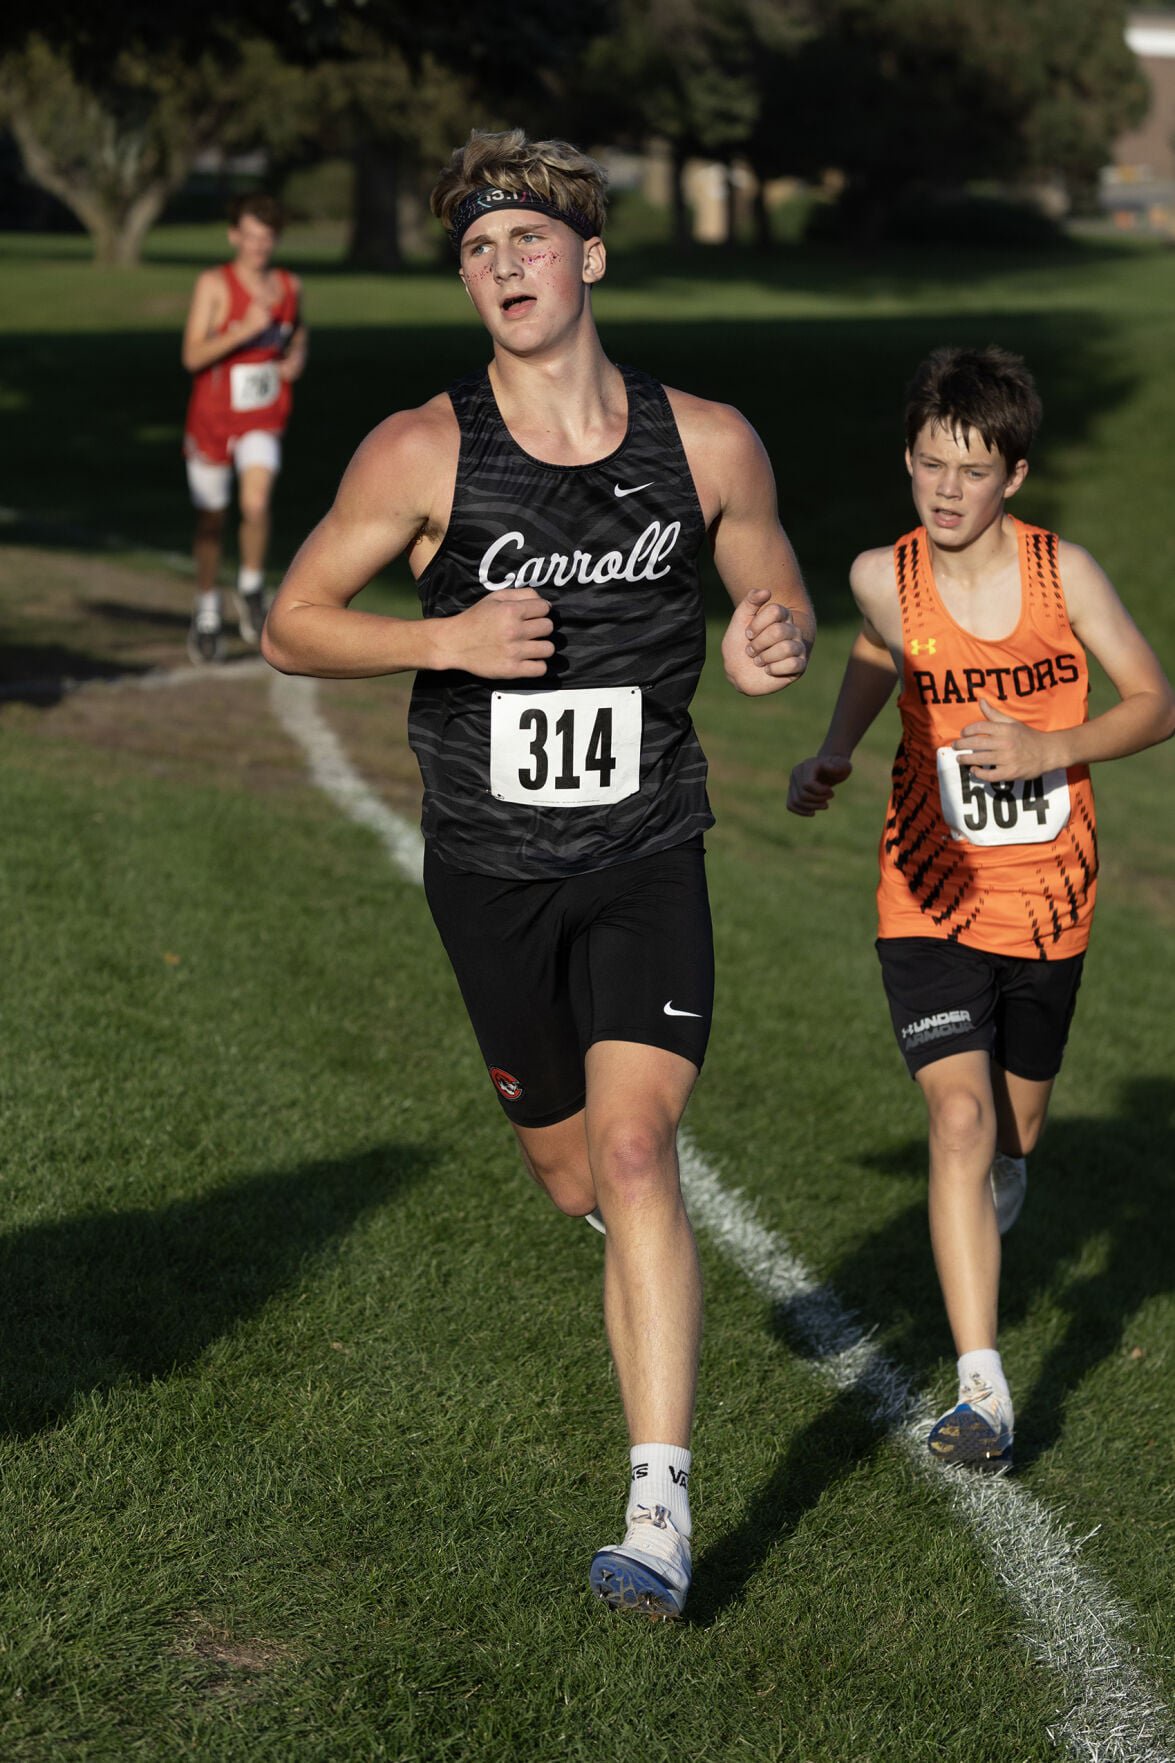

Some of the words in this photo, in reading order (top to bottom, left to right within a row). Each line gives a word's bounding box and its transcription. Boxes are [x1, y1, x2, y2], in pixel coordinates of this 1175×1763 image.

[478, 520, 681, 591] Carroll
[913, 654, 1080, 705] RAPTORS
[518, 708, 616, 791] 314
[959, 764, 1050, 831] 584
[913, 1010, 971, 1033] UNDER
